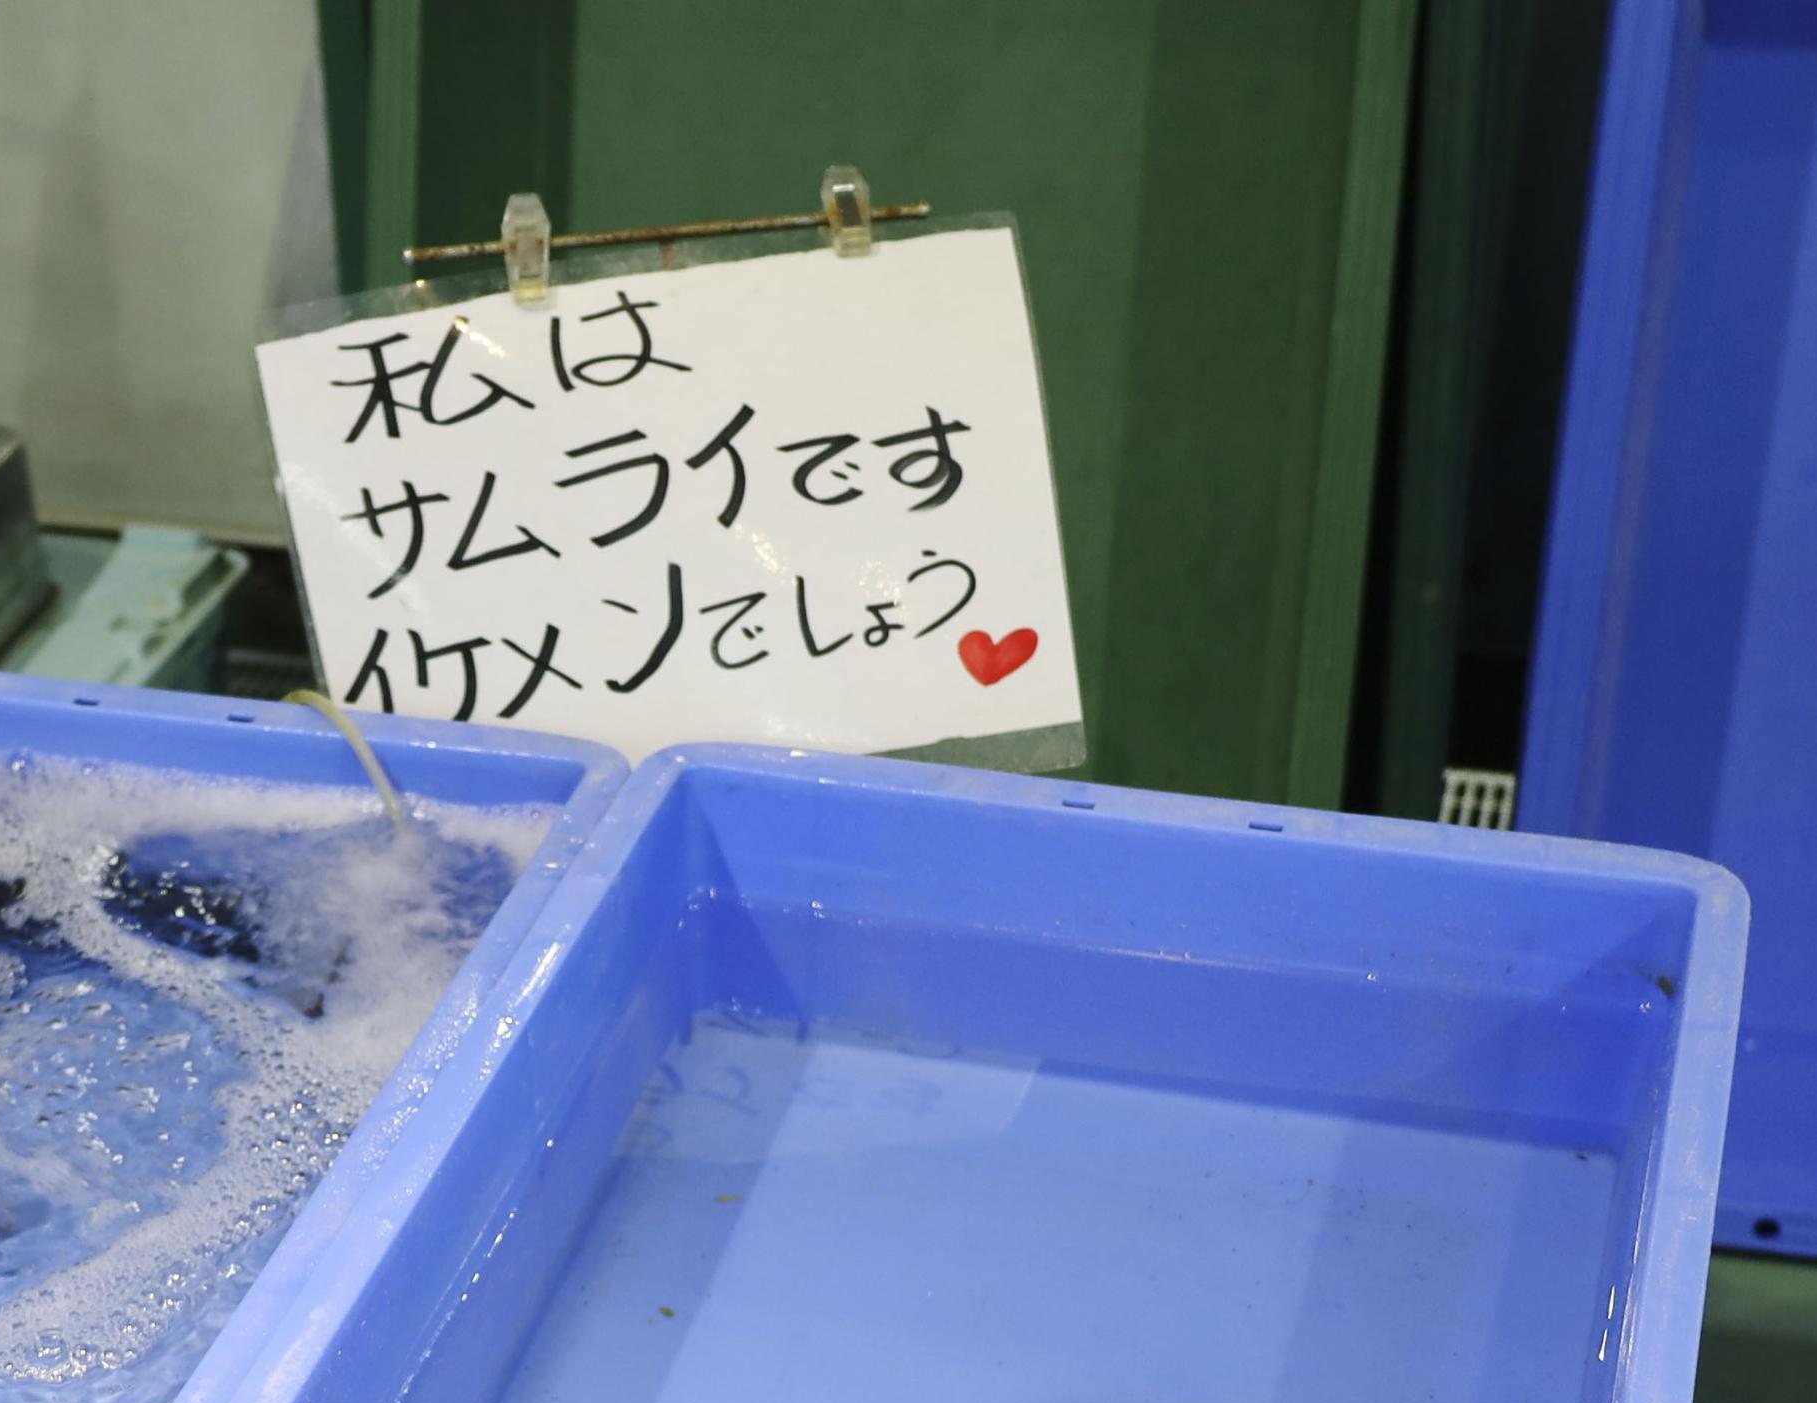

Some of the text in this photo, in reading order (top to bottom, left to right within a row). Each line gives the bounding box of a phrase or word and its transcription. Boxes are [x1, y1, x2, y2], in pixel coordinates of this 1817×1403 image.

[331, 291, 692, 443] 私は
[341, 404, 971, 599] サムライです
[344, 550, 977, 722] イケメンでしょう
